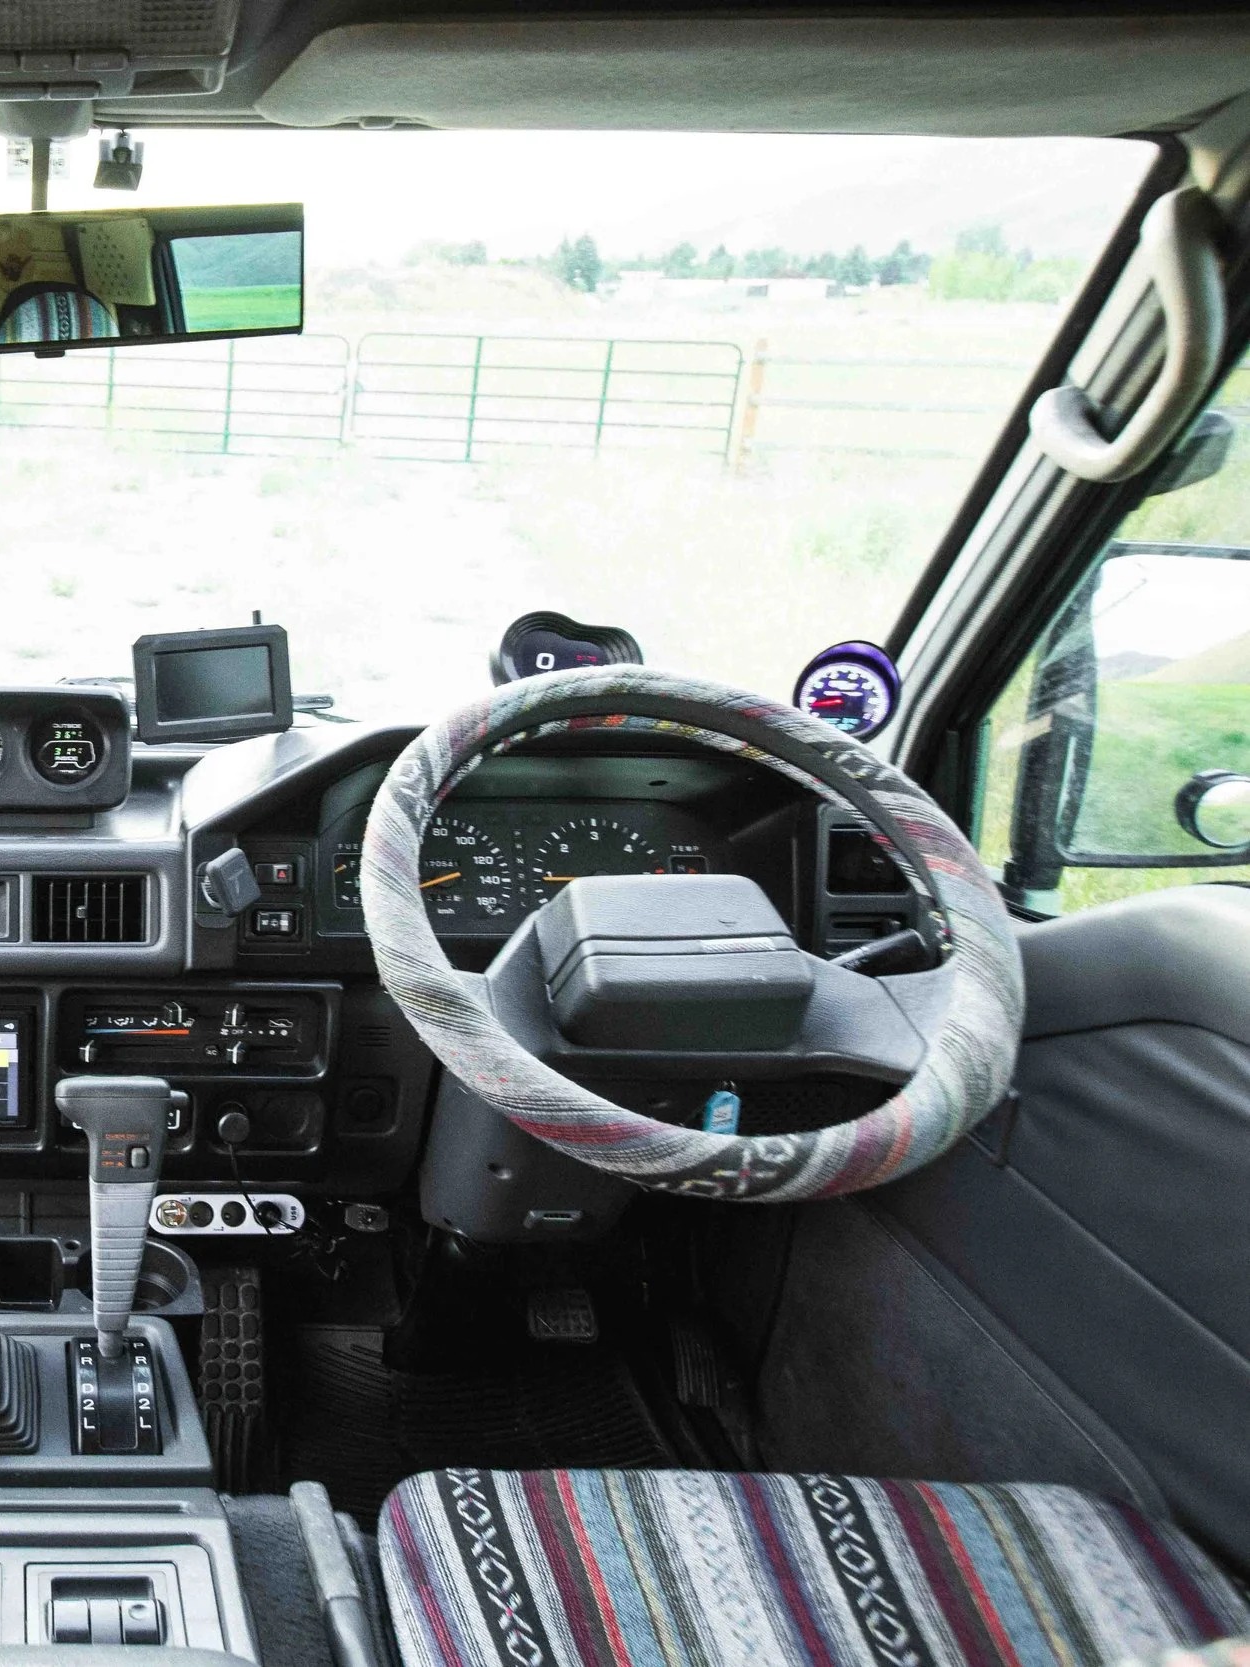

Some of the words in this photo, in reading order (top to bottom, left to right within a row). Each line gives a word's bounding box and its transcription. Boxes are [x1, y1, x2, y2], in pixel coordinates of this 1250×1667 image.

[535, 652, 555, 670] 0
[432, 828, 448, 836] 80
[589, 831, 599, 841] 3
[455, 836, 476, 845] 100
[559, 844, 569, 853] 2
[623, 844, 633, 853] 4
[473, 856, 494, 865] 120
[479, 875, 501, 885] 140
[476, 897, 497, 906] 160
[290, 1205, 298, 1221] USB
[80, 1356, 93, 1365] R
[134, 1356, 147, 1364] R
[82, 1383, 94, 1393] D
[137, 1382, 150, 1393] D
[83, 1399, 95, 1410] 2
[138, 1398, 151, 1410] 2
[83, 1417, 95, 1429] L
[139, 1416, 152, 1429] L
